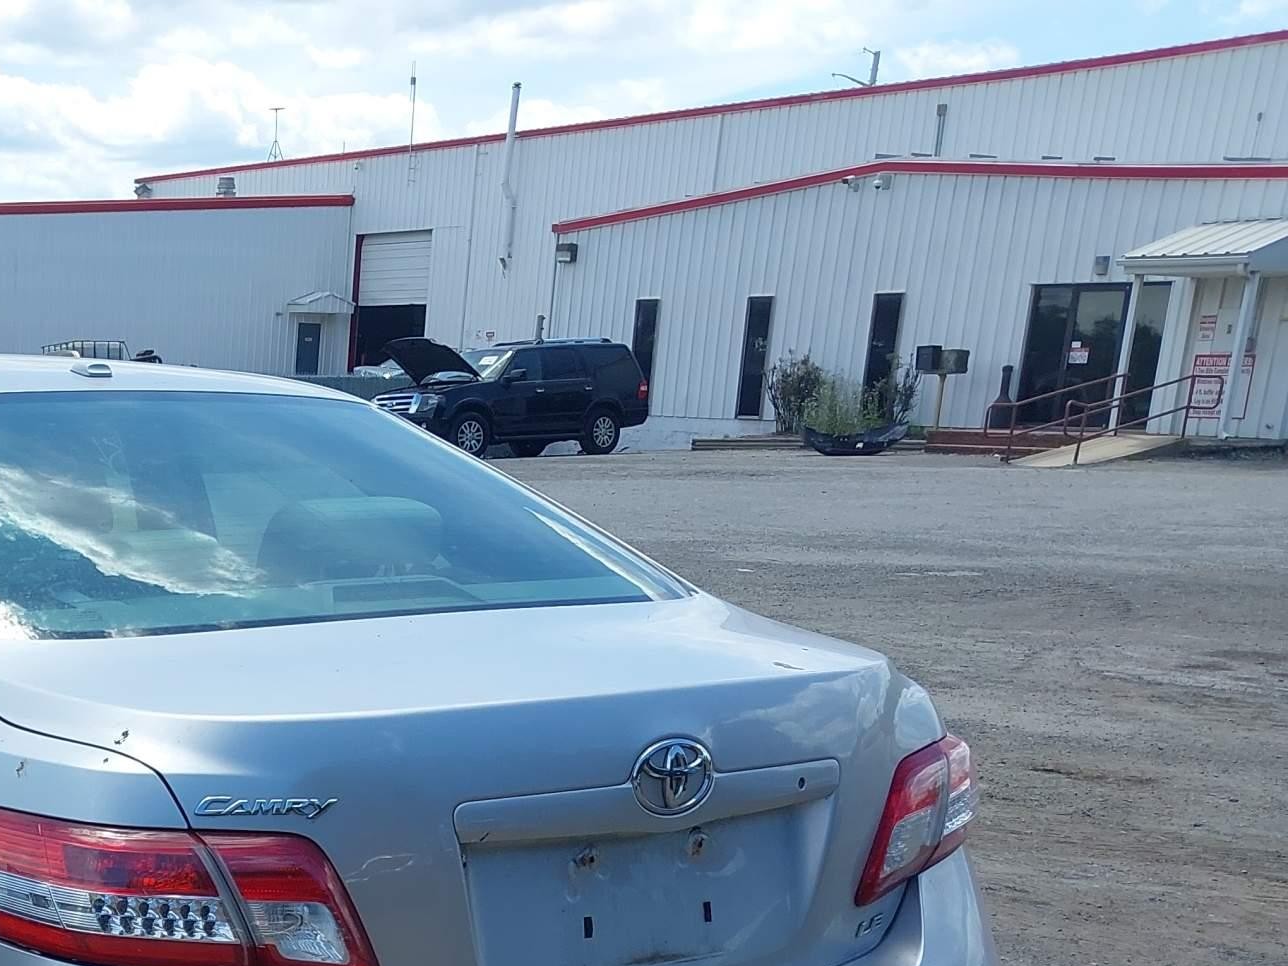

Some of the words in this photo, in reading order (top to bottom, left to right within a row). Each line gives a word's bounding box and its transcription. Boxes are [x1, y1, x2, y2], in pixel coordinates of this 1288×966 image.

[1196, 357, 1227, 366] ATTENTION
[193, 795, 339, 819] CAMRY
[855, 912, 883, 938] LE
